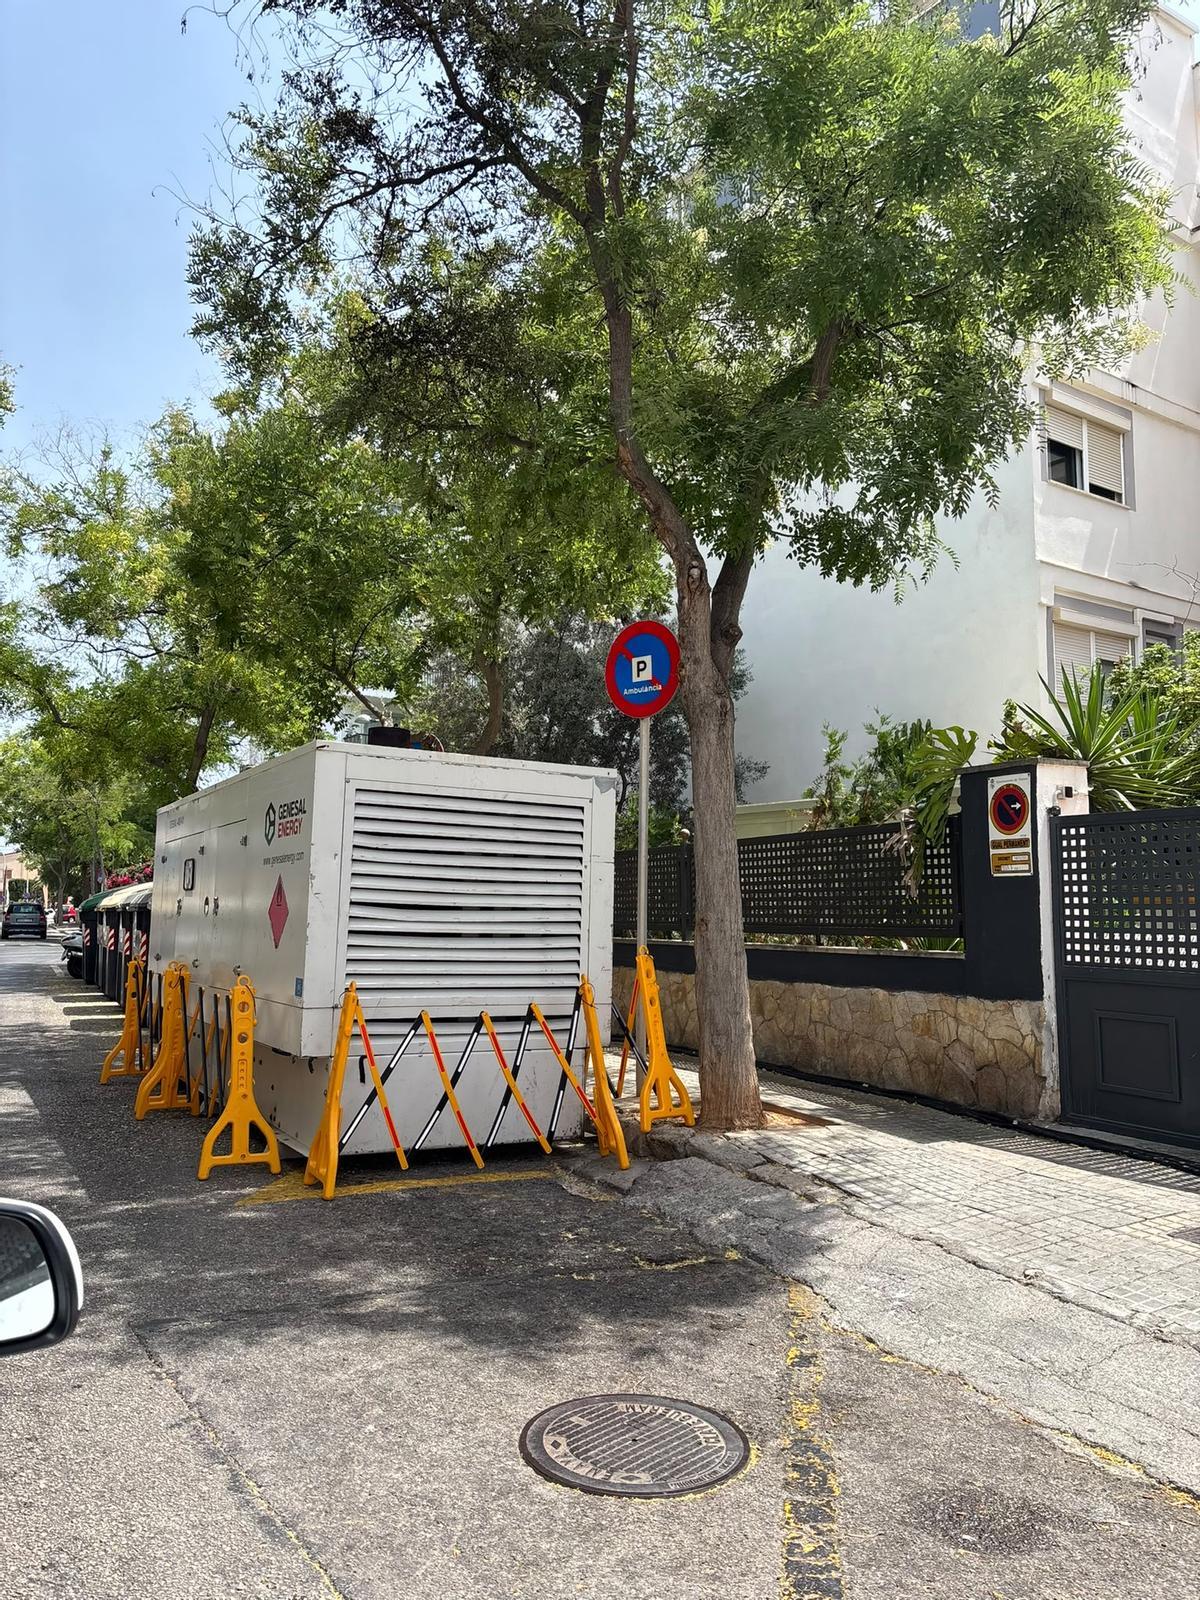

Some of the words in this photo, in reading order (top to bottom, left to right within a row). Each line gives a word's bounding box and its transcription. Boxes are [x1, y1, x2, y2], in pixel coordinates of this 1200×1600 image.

[637, 660, 647, 678] P
[278, 798, 307, 820] GENESAL
[278, 818, 303, 838] ENERGY
